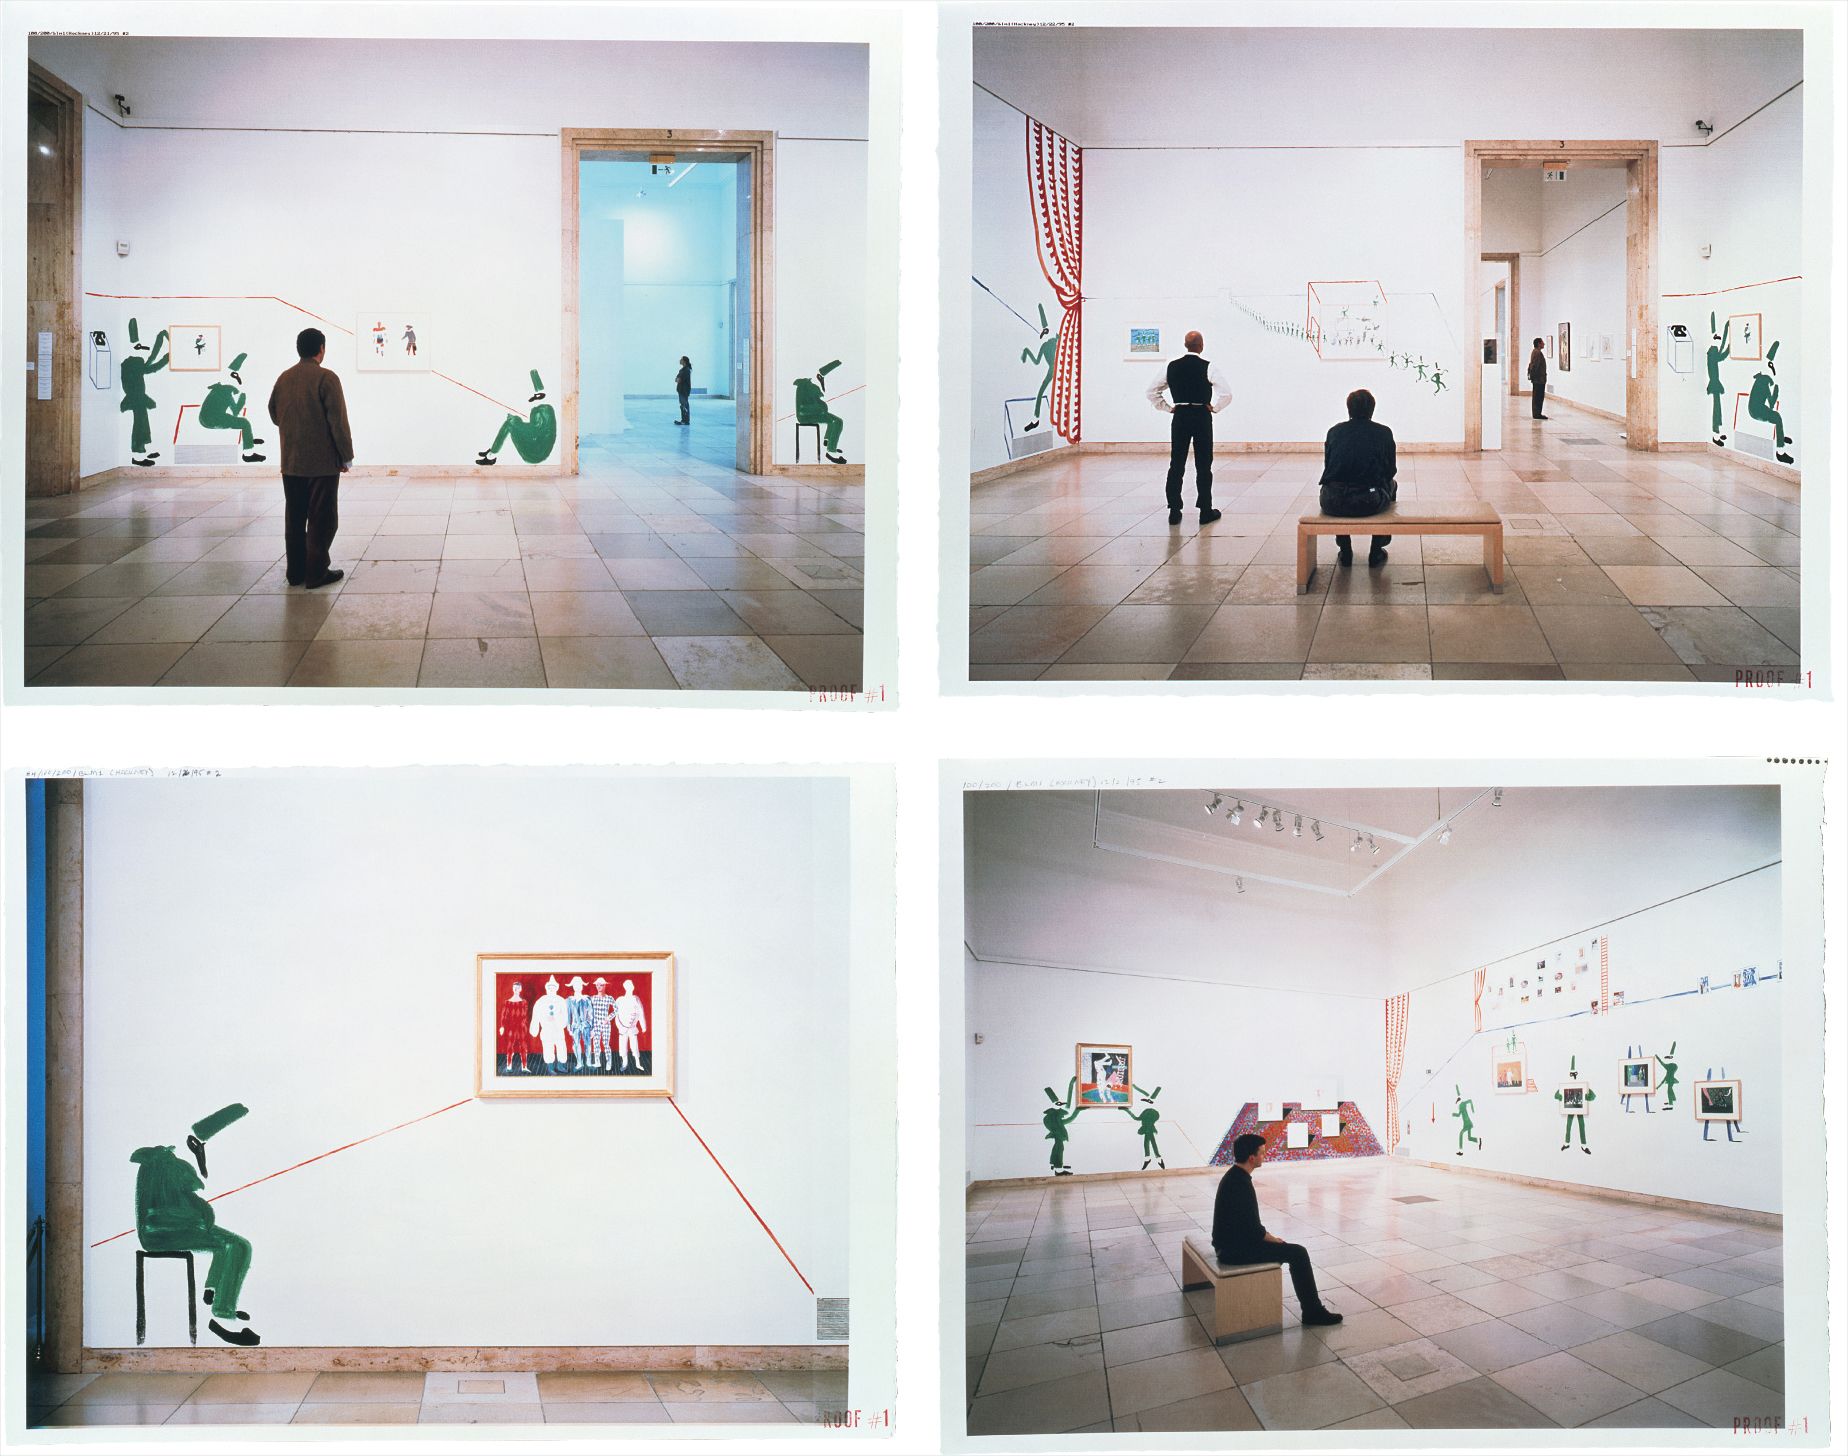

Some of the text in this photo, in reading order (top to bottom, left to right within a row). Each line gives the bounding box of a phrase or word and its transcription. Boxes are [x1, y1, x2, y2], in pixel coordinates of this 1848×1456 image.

[667, 129, 673, 138] 3
[1559, 140, 1565, 149] 3
[1735, 669, 1784, 688] PROOF
[809, 684, 885, 703] PROOF #1
[868, 1409, 889, 1429] #1
[1788, 1416, 1808, 1435] #1
